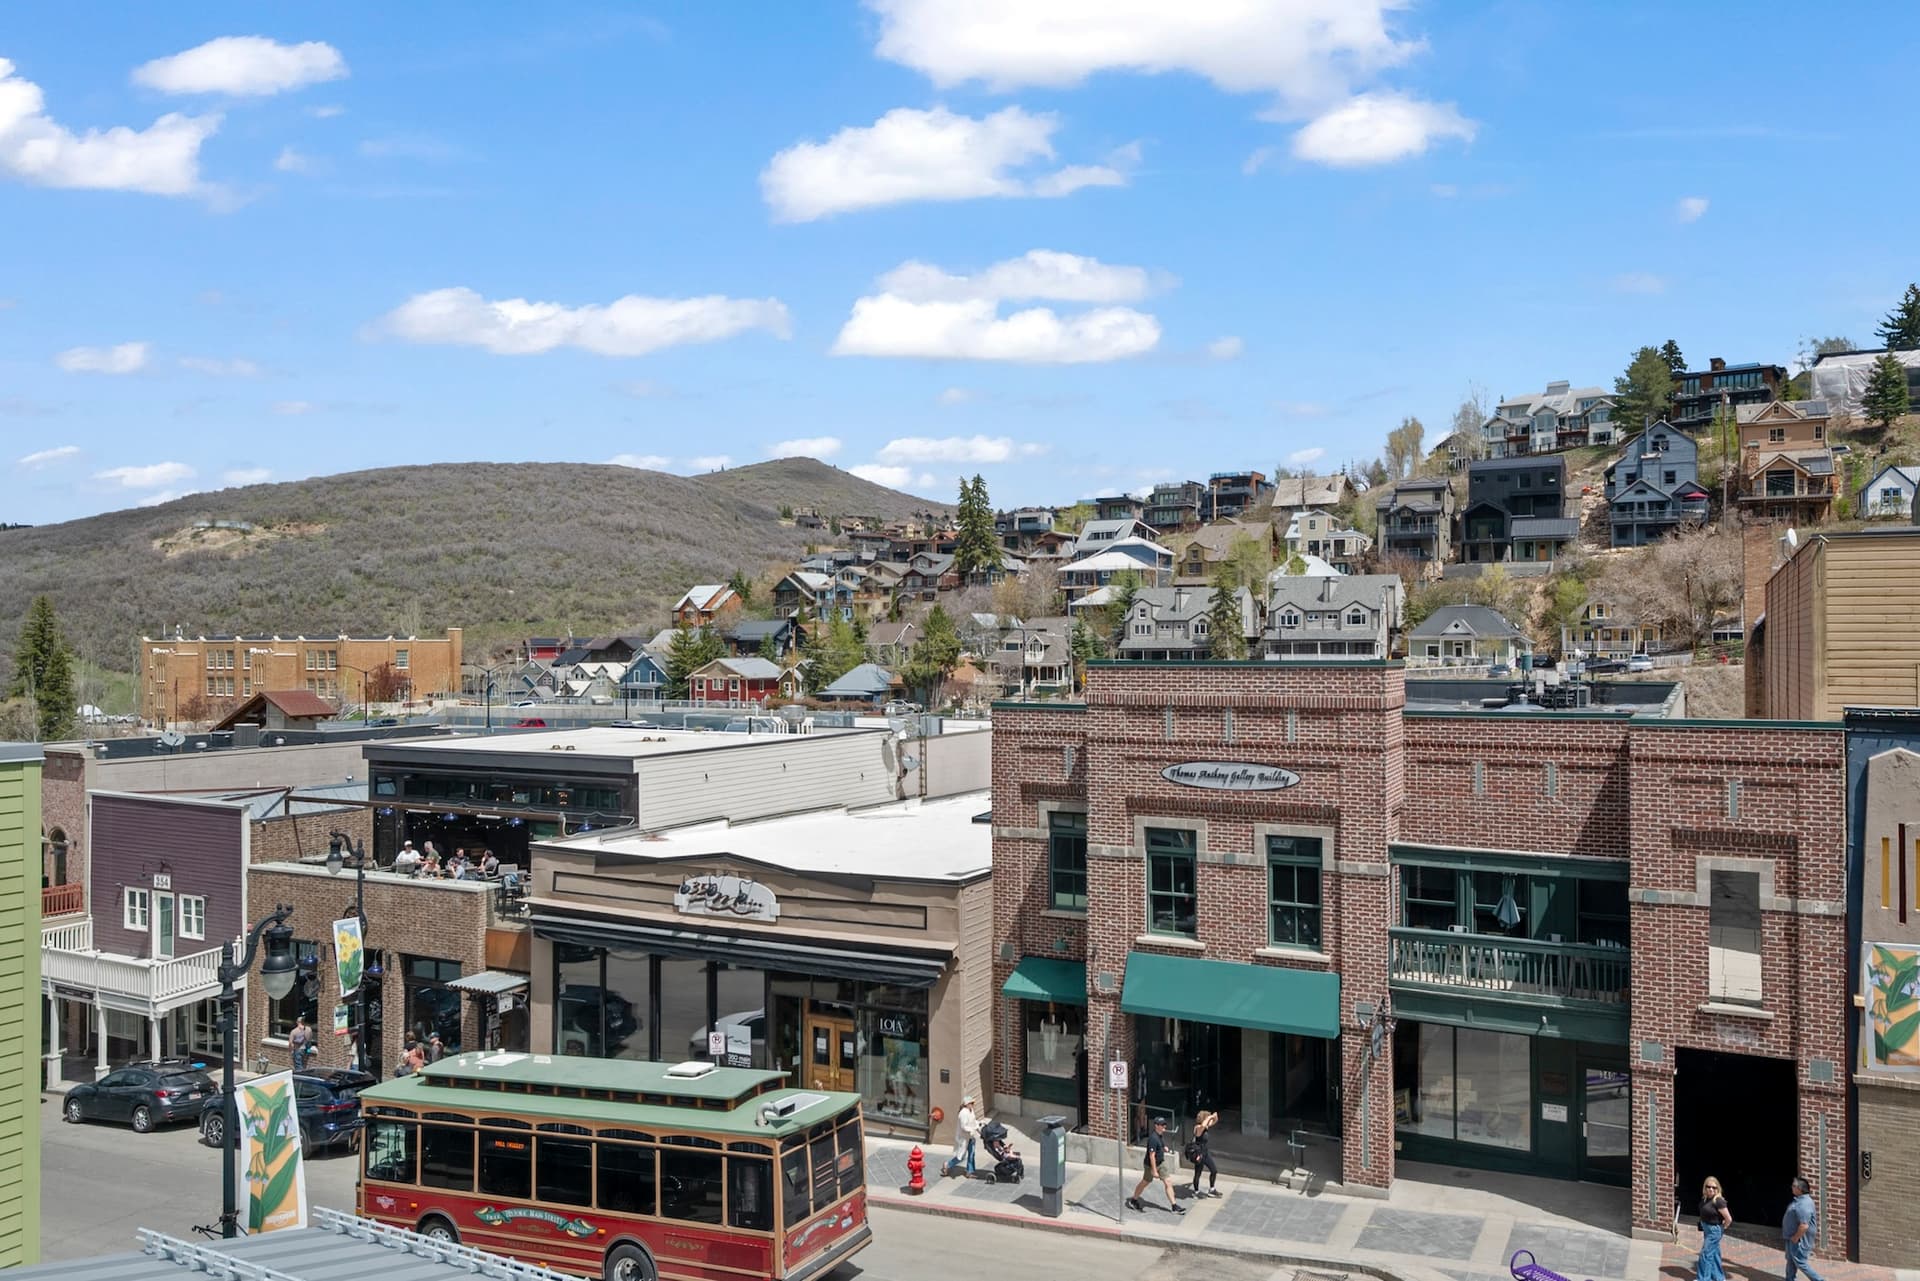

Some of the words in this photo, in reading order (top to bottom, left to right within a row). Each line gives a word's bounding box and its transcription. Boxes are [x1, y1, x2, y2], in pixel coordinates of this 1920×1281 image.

[1169, 766, 1197, 779] Thomas
[1230, 768, 1256, 787] Gallery
[1257, 770, 1291, 786] Building
